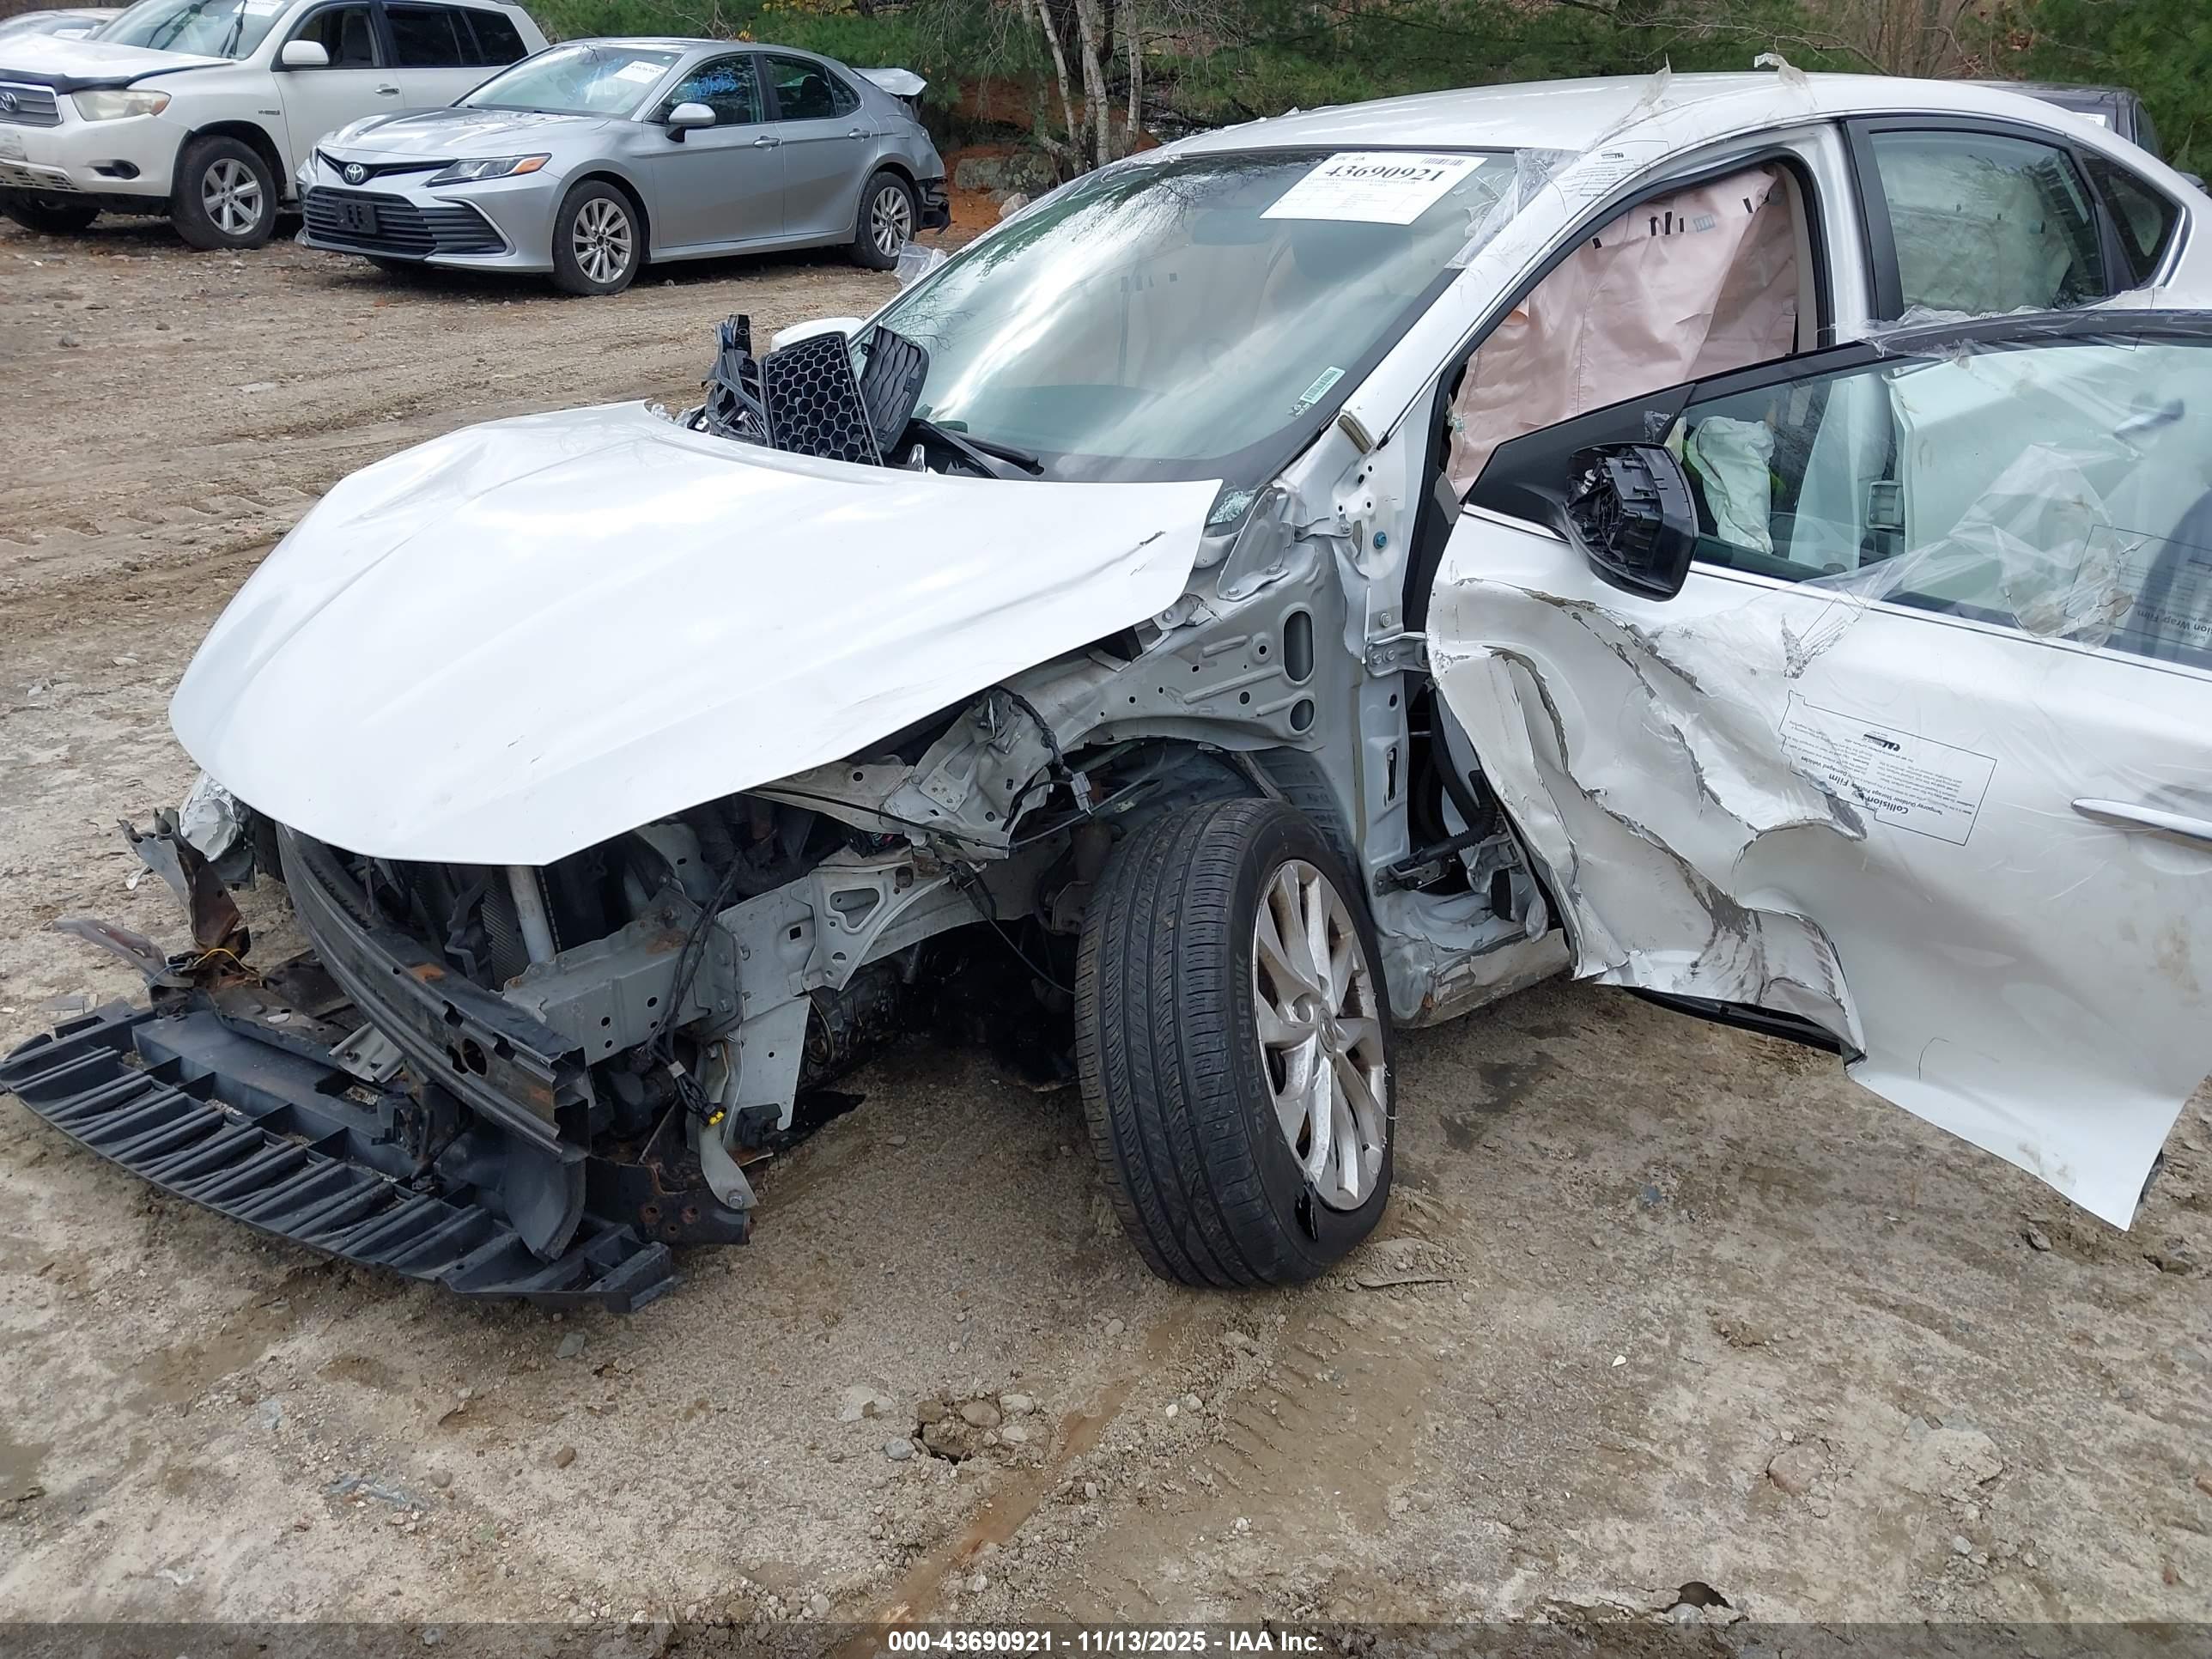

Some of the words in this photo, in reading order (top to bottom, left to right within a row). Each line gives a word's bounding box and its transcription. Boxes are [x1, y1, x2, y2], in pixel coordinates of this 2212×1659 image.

[1325, 164, 1445, 182] 43690921
[2137, 611, 2159, 623] Film
[2164, 616, 2191, 630] Wrap
[1801, 756, 1821, 768] Vehicles
[1822, 763, 1847, 776] Damaged
[1828, 774, 1850, 787] Film
[1872, 790, 1893, 800] Storage
[1867, 795, 1909, 815] Collision
[1893, 797, 1917, 807] Outdoor
